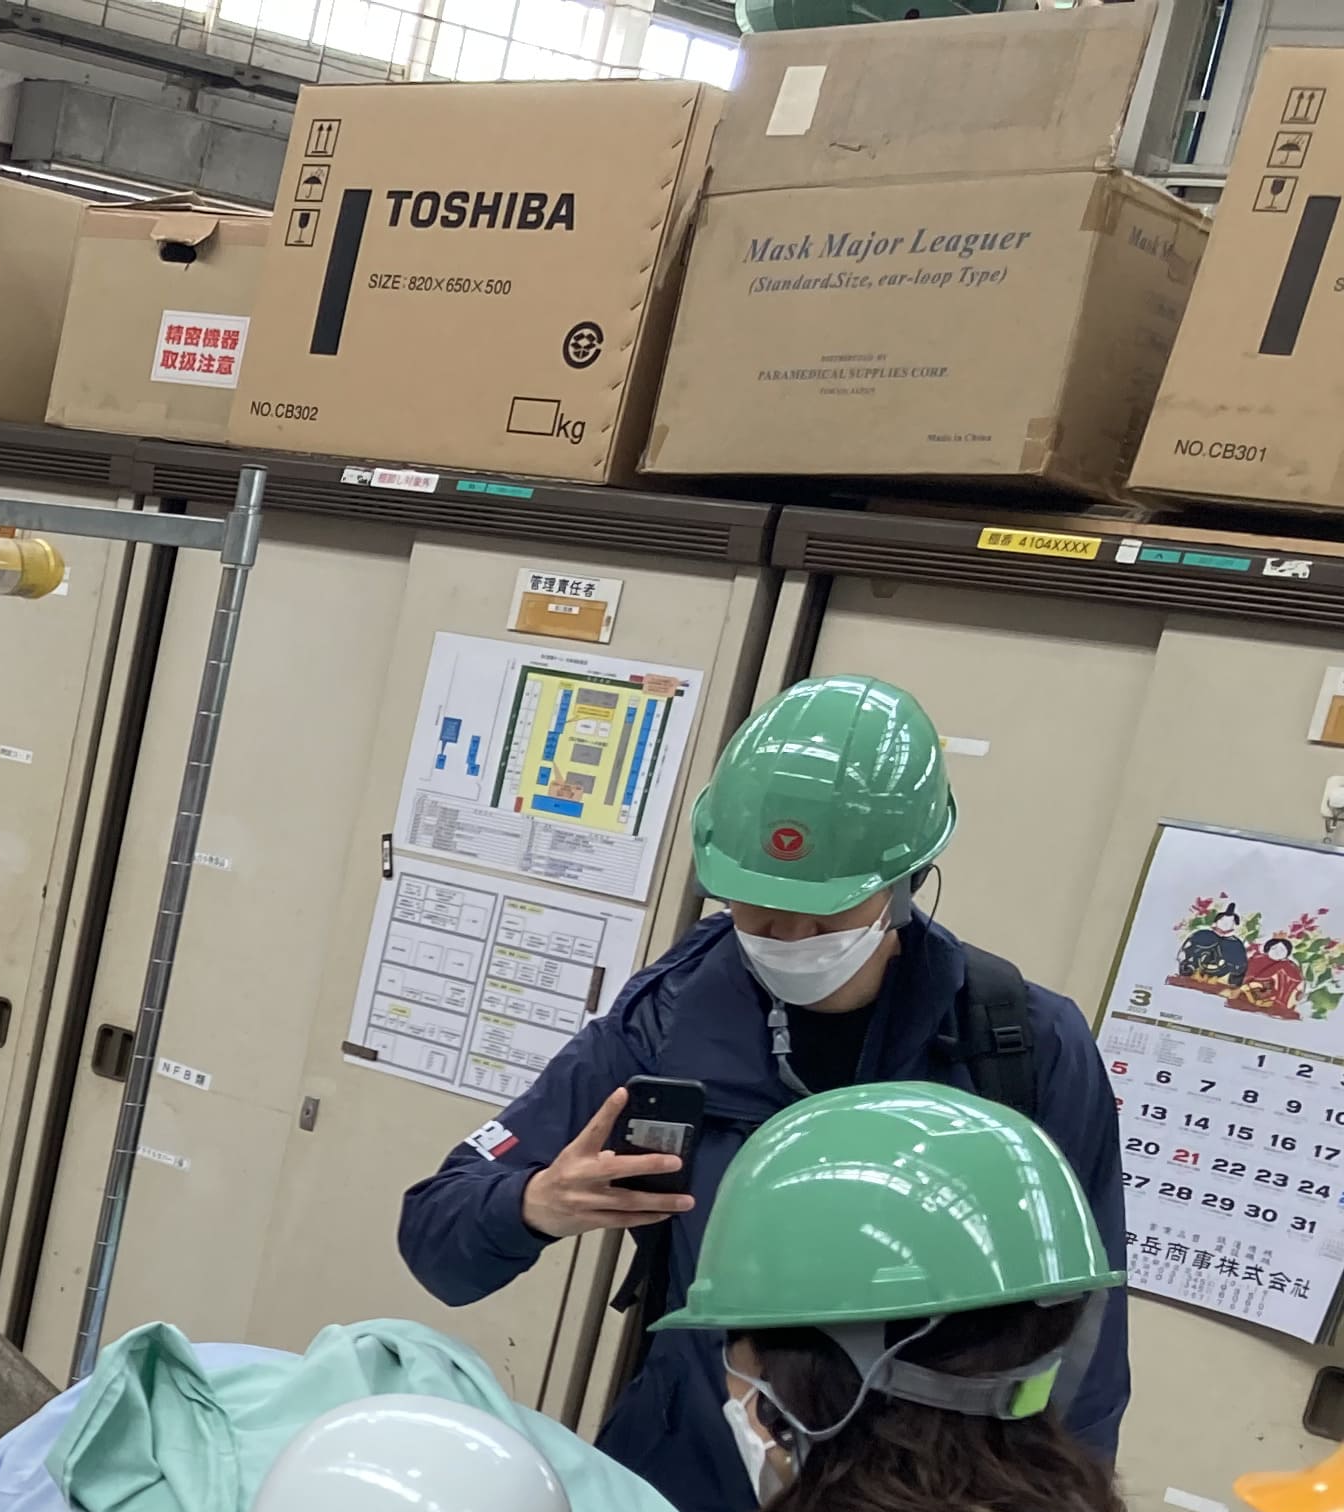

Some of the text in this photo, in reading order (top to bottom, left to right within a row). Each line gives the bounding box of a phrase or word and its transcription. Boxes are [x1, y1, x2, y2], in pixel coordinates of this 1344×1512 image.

[386, 190, 575, 231] TOSHIBA
[742, 228, 1032, 263] Mask Major Leaguer
[878, 269, 953, 289] ear-loop
[958, 265, 1008, 286] Type)
[165, 324, 240, 351] 精密機器
[160, 350, 235, 375] 取扱注意
[758, 368, 846, 381] PARAMEDICAL
[848, 367, 909, 380] SUPPLIES
[249, 401, 318, 422] NO.CB302
[556, 413, 586, 444] kg
[1174, 439, 1266, 462] NO.CB301
[530, 574, 596, 598] 管理責任者
[1129, 989, 1152, 1007] 3
[1256, 1054, 1314, 1078] 1 2
[1112, 1060, 1129, 1075] 5
[1155, 1070, 1172, 1084] 6
[1199, 1079, 1216, 1093] 7
[1242, 1089, 1259, 1104] 8
[1285, 1100, 1302, 1115] 9
[1140, 1102, 1341, 1162] 13 14 15 16 17
[1125, 1137, 1332, 1199] 20 21 22 23 24
[1158, 1181, 1193, 1202] 28
[1201, 1192, 1235, 1212] 29
[1243, 1203, 1278, 1223] 30
[1290, 1215, 1317, 1235] 31
